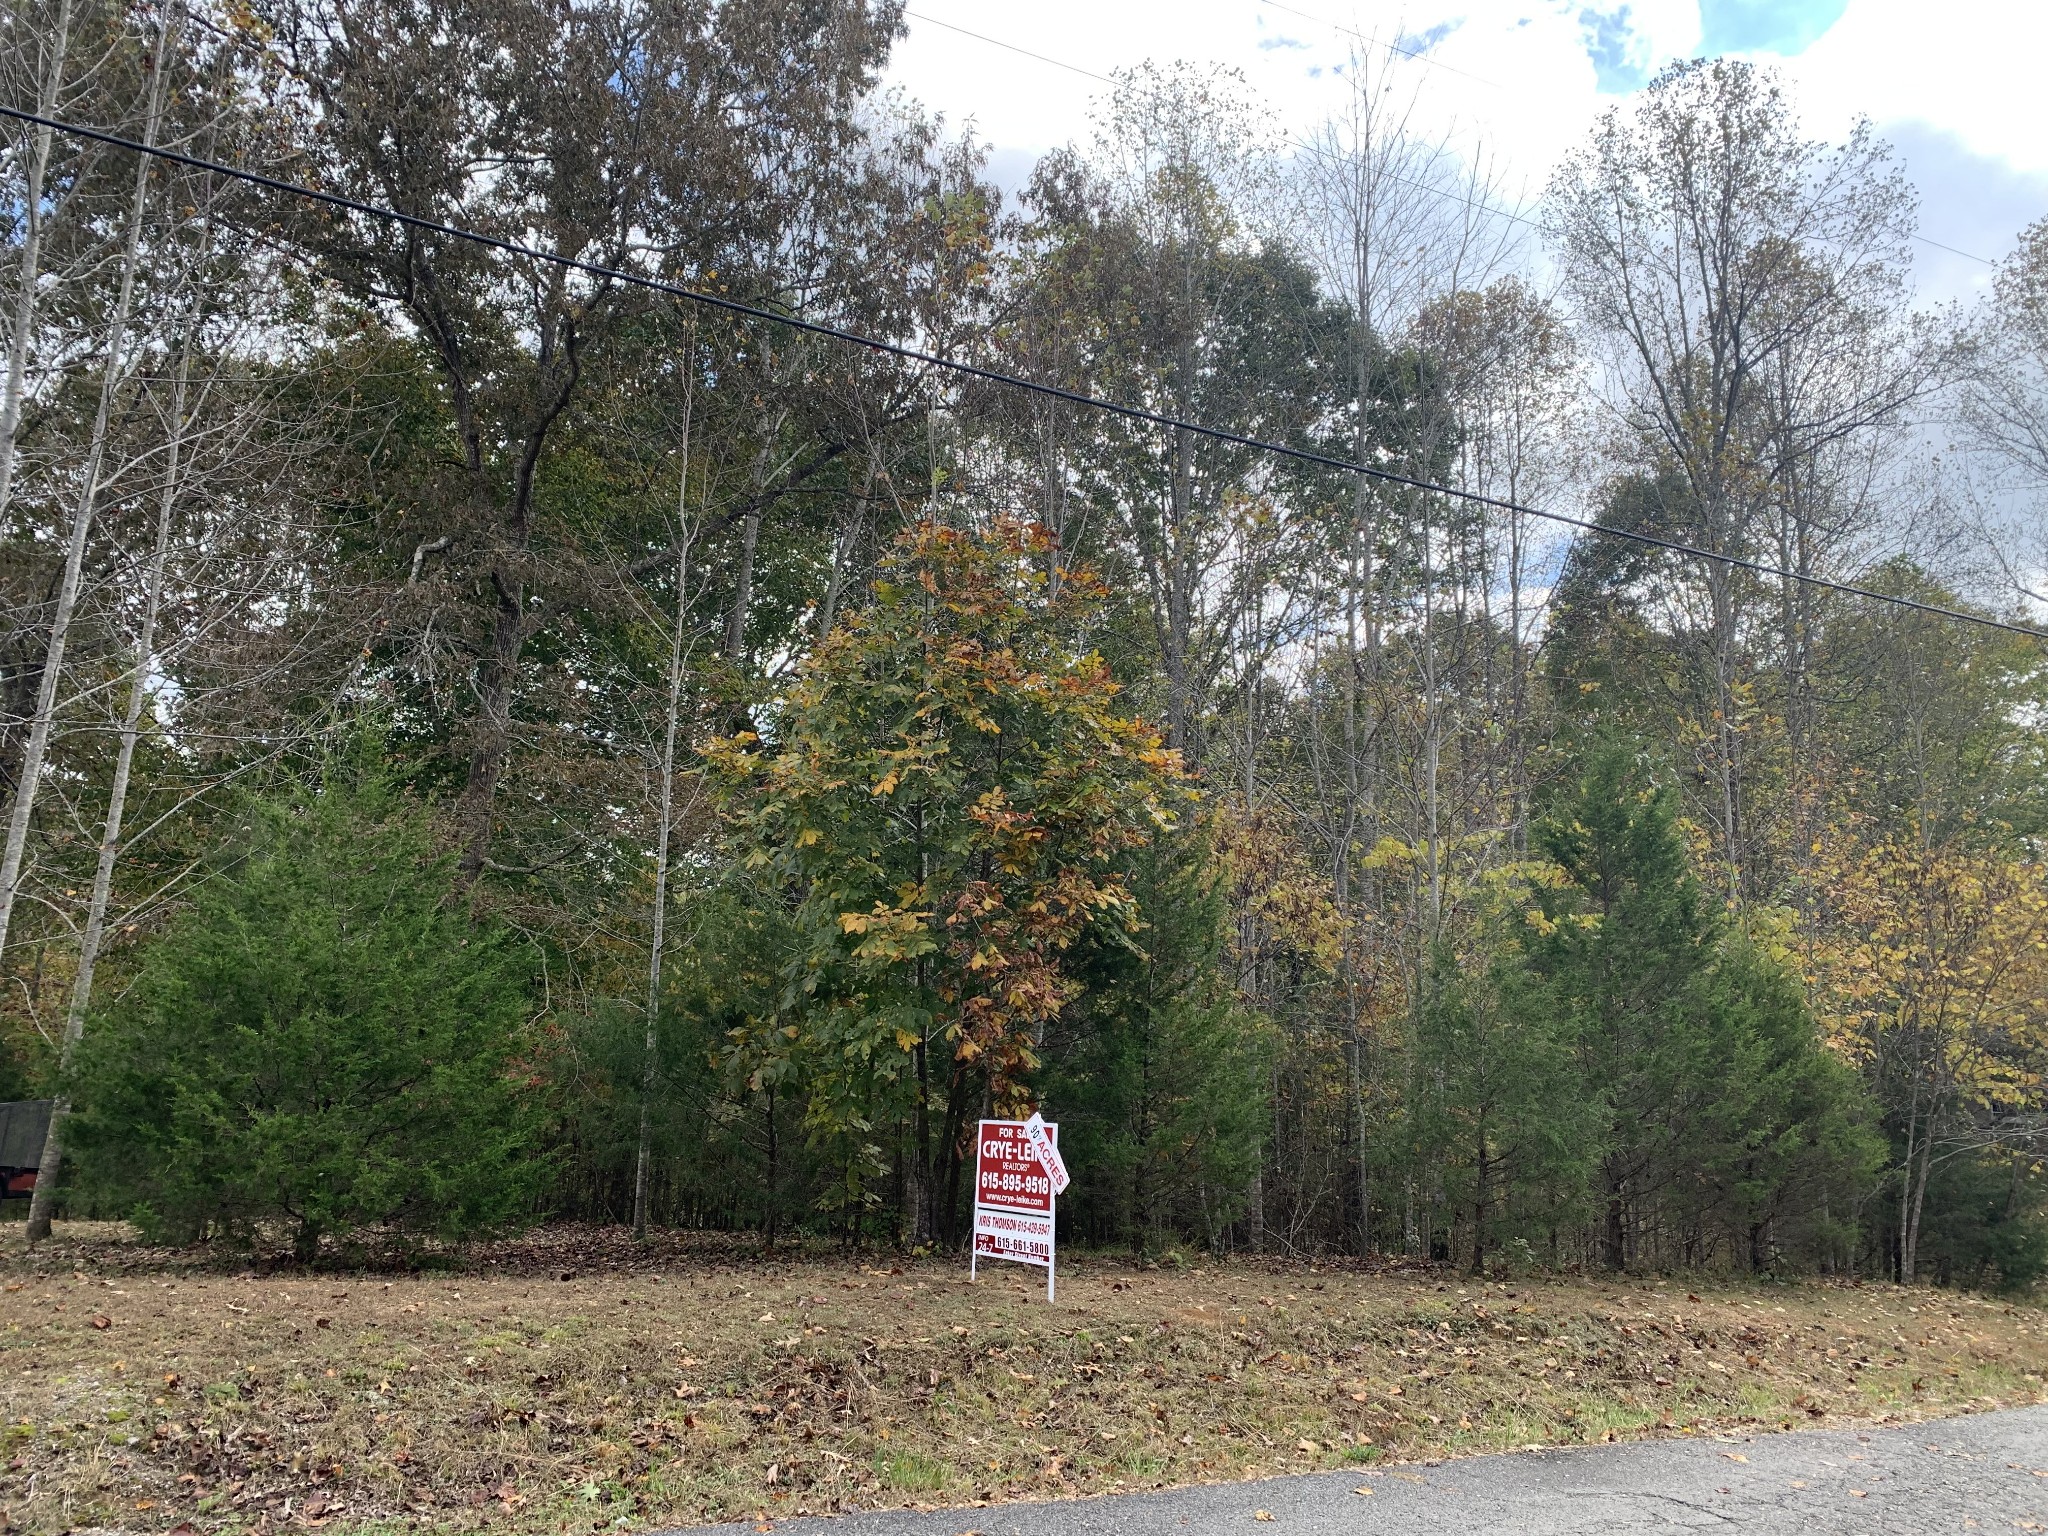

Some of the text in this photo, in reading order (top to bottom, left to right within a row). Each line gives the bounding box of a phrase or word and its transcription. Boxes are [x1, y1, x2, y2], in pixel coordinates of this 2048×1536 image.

[998, 1128, 1030, 1139] FOR SAL
[982, 1140, 1039, 1162] CRYE-LEI
[1037, 1141, 1064, 1186] ACRES
[981, 1171, 1049, 1195] 615-895-9518
[986, 1193, 1044, 1207] www.crye-leike.com
[992, 1217, 1017, 1231] THOMSON
[978, 1242, 993, 1252] 24-7
[997, 1236, 1049, 1255] 615-661-5800
